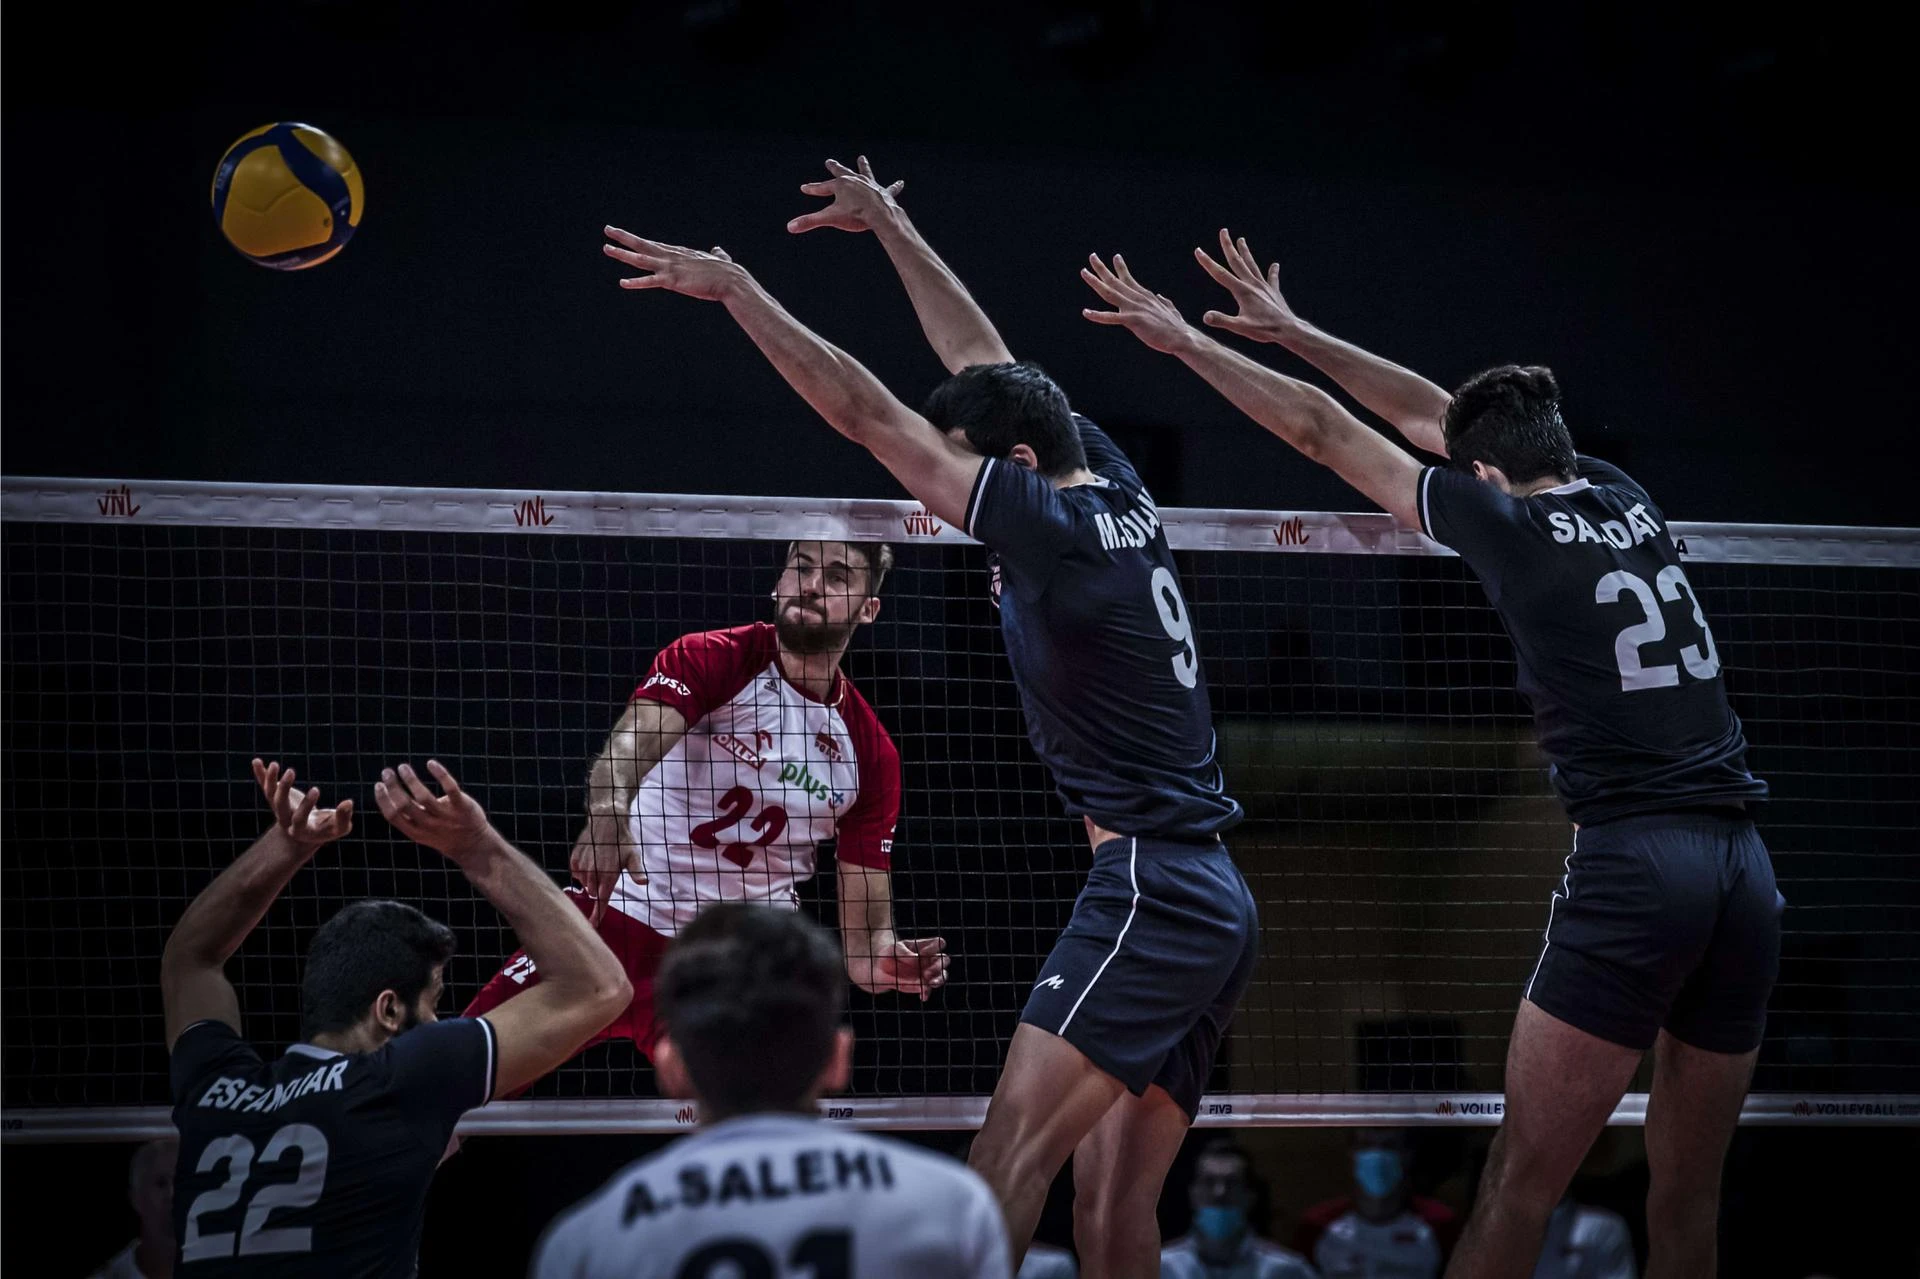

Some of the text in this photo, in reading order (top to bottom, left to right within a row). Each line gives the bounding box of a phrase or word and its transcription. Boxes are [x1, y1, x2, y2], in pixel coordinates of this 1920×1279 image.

[97, 484, 140, 516] VNL
[513, 495, 554, 527] VNL
[903, 508, 943, 537] VNL
[1273, 516, 1310, 546] VNL
[1151, 566, 1199, 689] 9
[1595, 564, 1721, 692] 23
[777, 763, 830, 801] plus
[503, 954, 537, 985] 22
[675, 1105, 854, 1124] VNL FIVB
[1209, 1104, 1233, 1115] FIVB
[1816, 1103, 1896, 1116] VOLLEYBALL
[181, 1122, 330, 1264] 22
[620, 1149, 894, 1228] A.SALEHI
